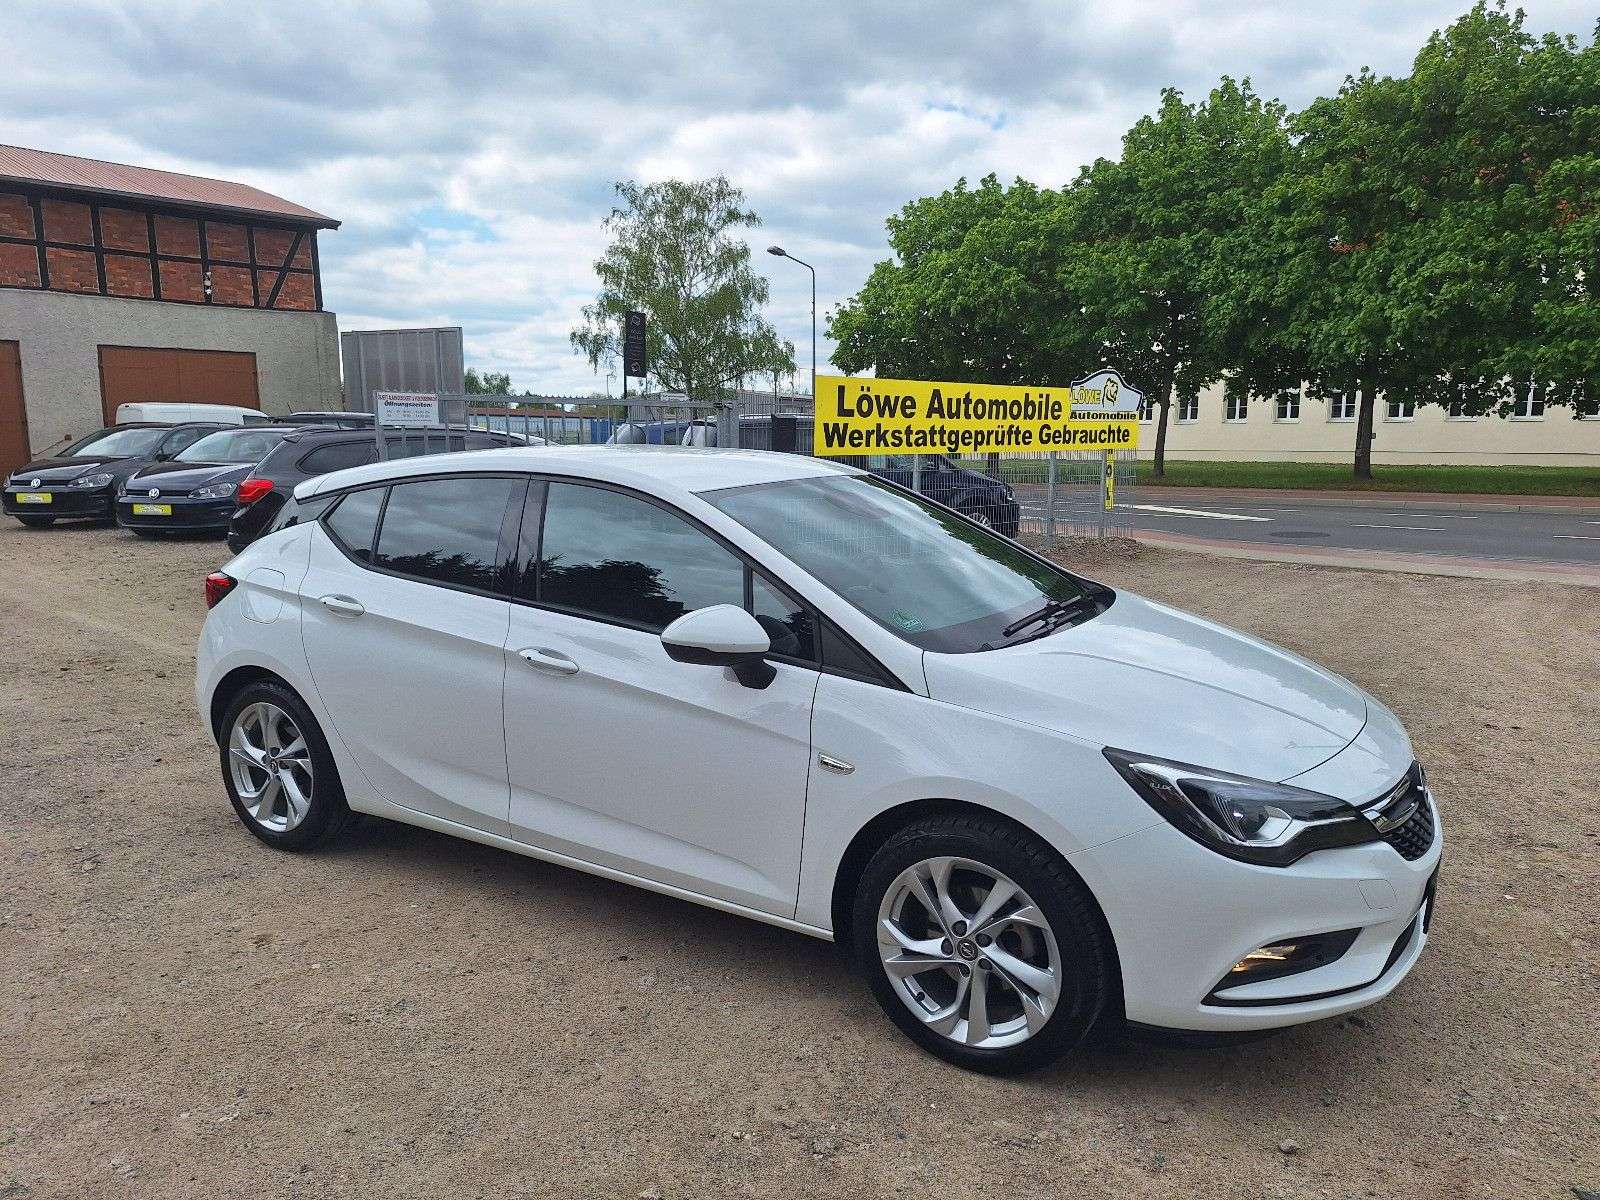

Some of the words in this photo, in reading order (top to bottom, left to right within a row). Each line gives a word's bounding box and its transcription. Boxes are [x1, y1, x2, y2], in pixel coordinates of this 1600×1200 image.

[837, 385, 917, 418] Löwe
[926, 388, 1063, 421] Automobile
[1071, 386, 1101, 404] LÖWE
[1069, 411, 1137, 420] Automobile
[823, 422, 1033, 452] Werkstattgeprüfte
[1038, 423, 1130, 445] Gebrauchte
